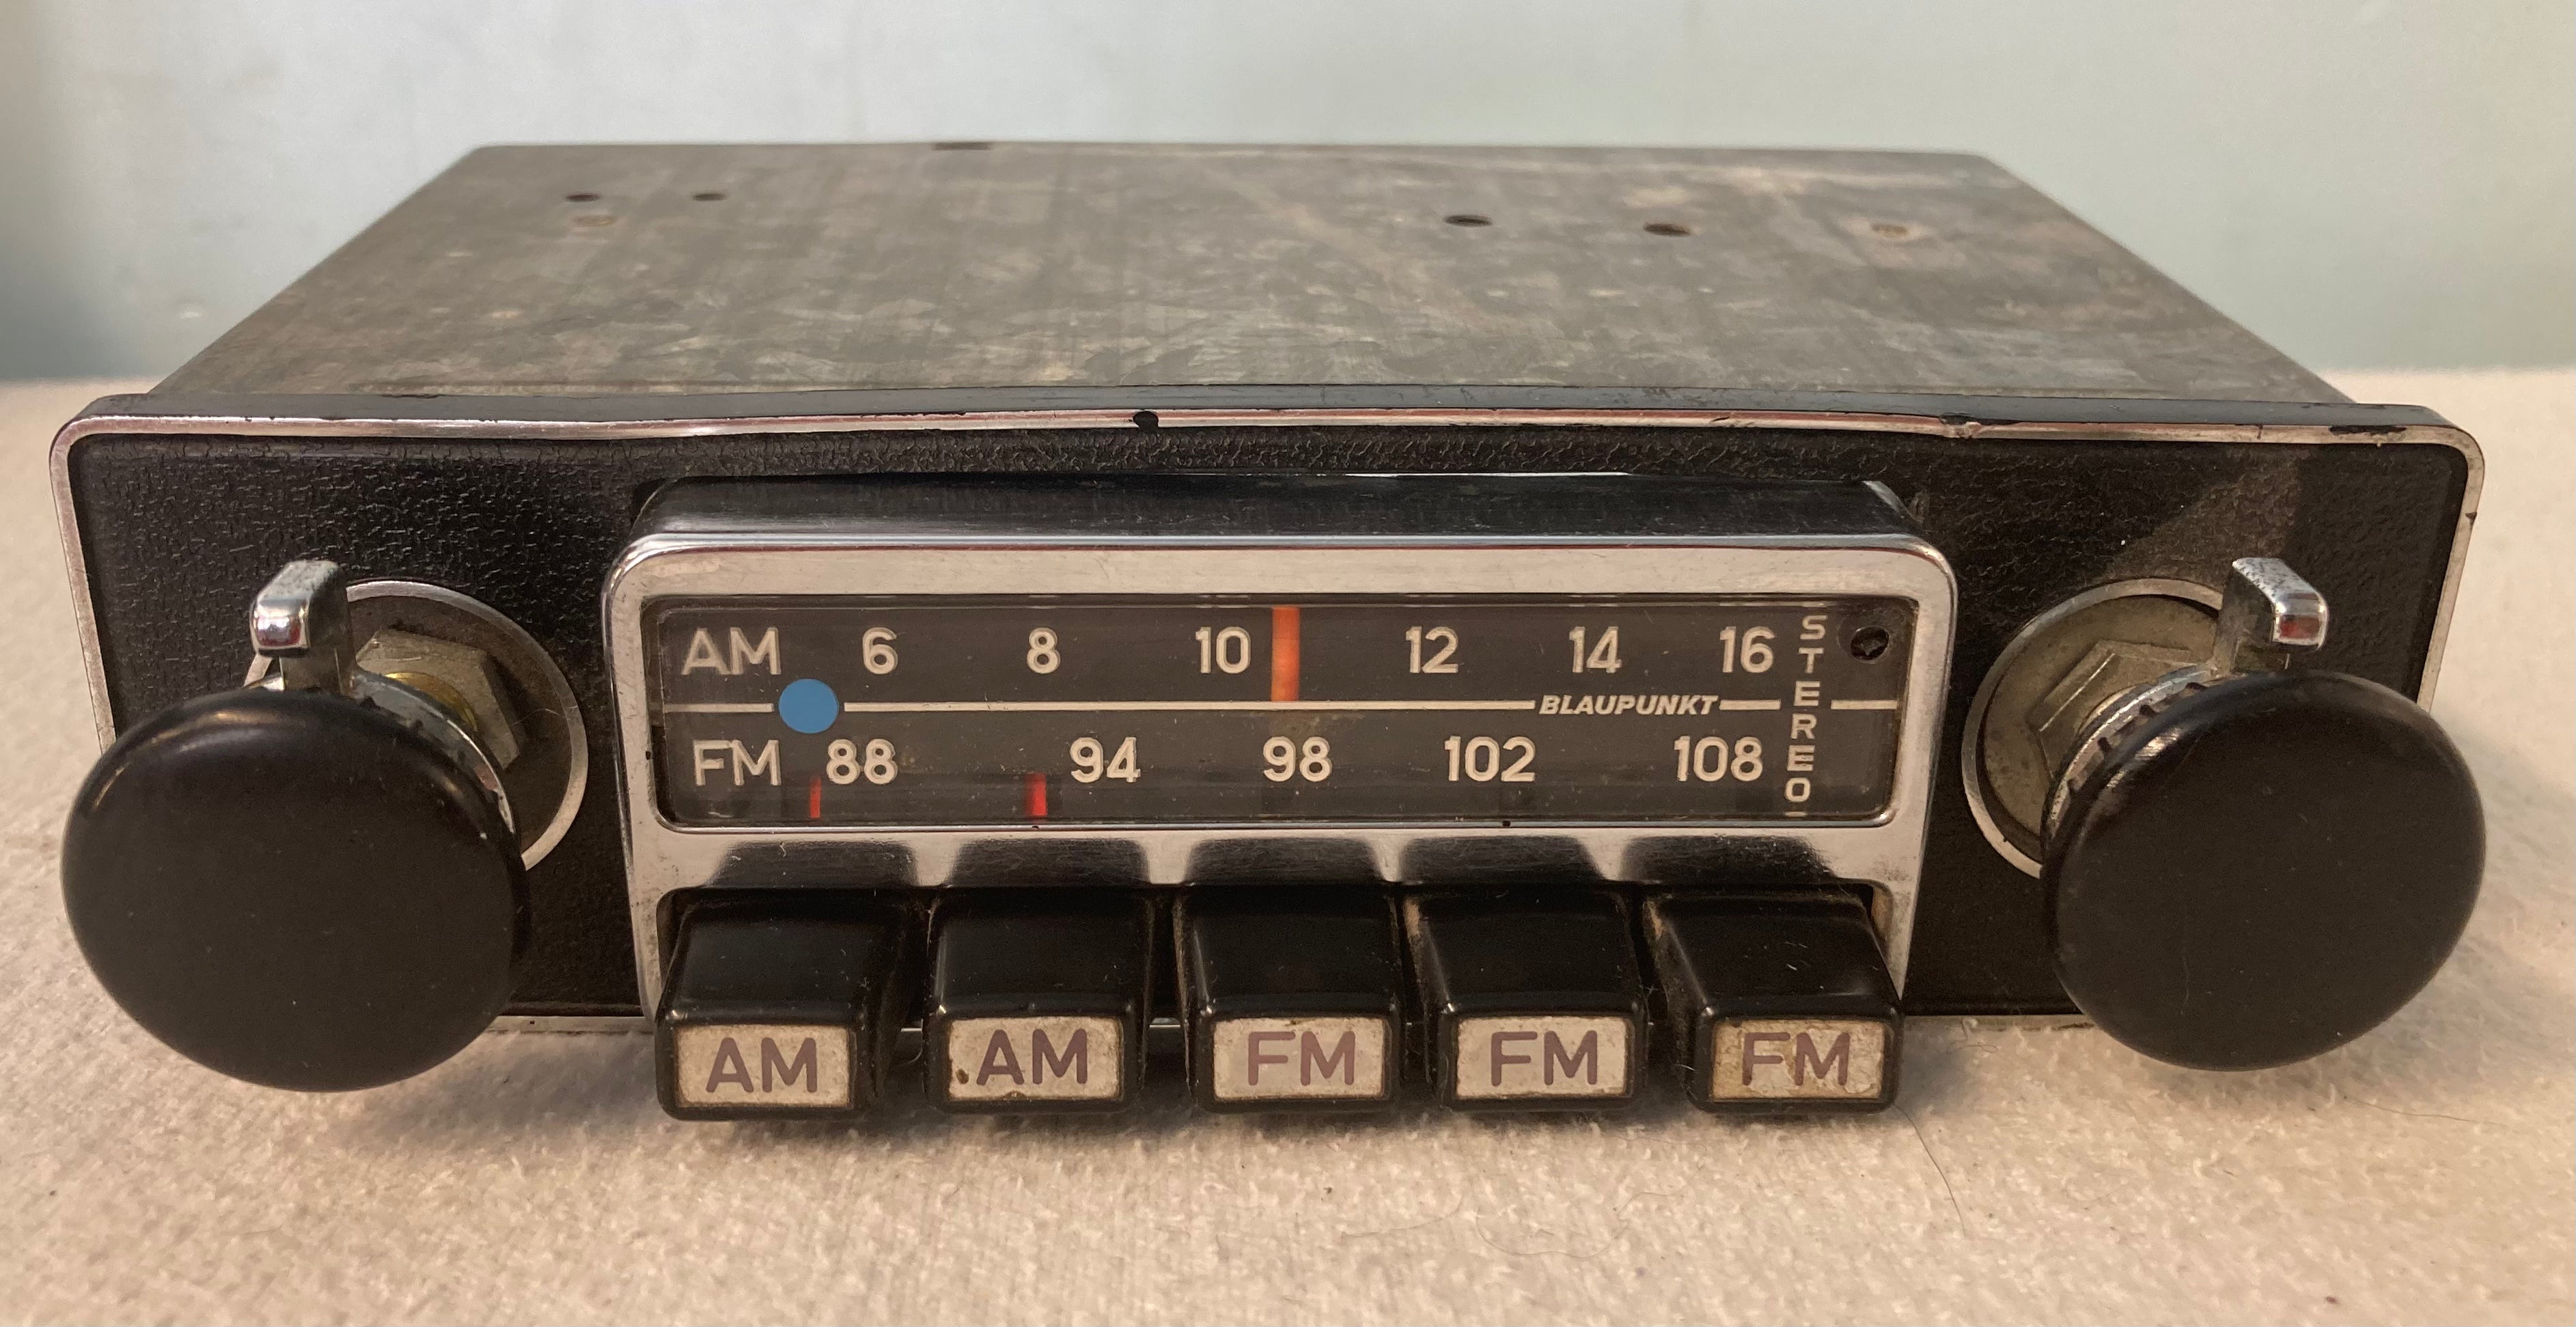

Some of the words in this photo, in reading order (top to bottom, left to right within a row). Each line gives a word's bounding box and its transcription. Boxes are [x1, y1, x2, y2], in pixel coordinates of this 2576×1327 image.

[681, 628, 781, 675] AM
[862, 627, 898, 674] 6
[1027, 628, 1060, 674] 8
[1195, 626, 1251, 673] 10
[1406, 626, 1458, 673] 12
[1569, 626, 1622, 673] 14
[1719, 626, 1775, 673] 16
[1539, 695, 1719, 715] BLAUPUNKT
[1784, 615, 1827, 802] STEREO
[693, 740, 781, 786] FM
[827, 739, 898, 785] 88
[1070, 737, 1141, 783] 94
[1263, 736, 1333, 782] 98
[1444, 736, 1536, 782] 102
[1674, 736, 1763, 782] 108
[705, 1037, 818, 1093] AM
[975, 1029, 1088, 1086] AM
[1247, 1031, 1356, 1086] FM
[1490, 1030, 1598, 1086] FM
[1742, 1031, 1850, 1087] FM
